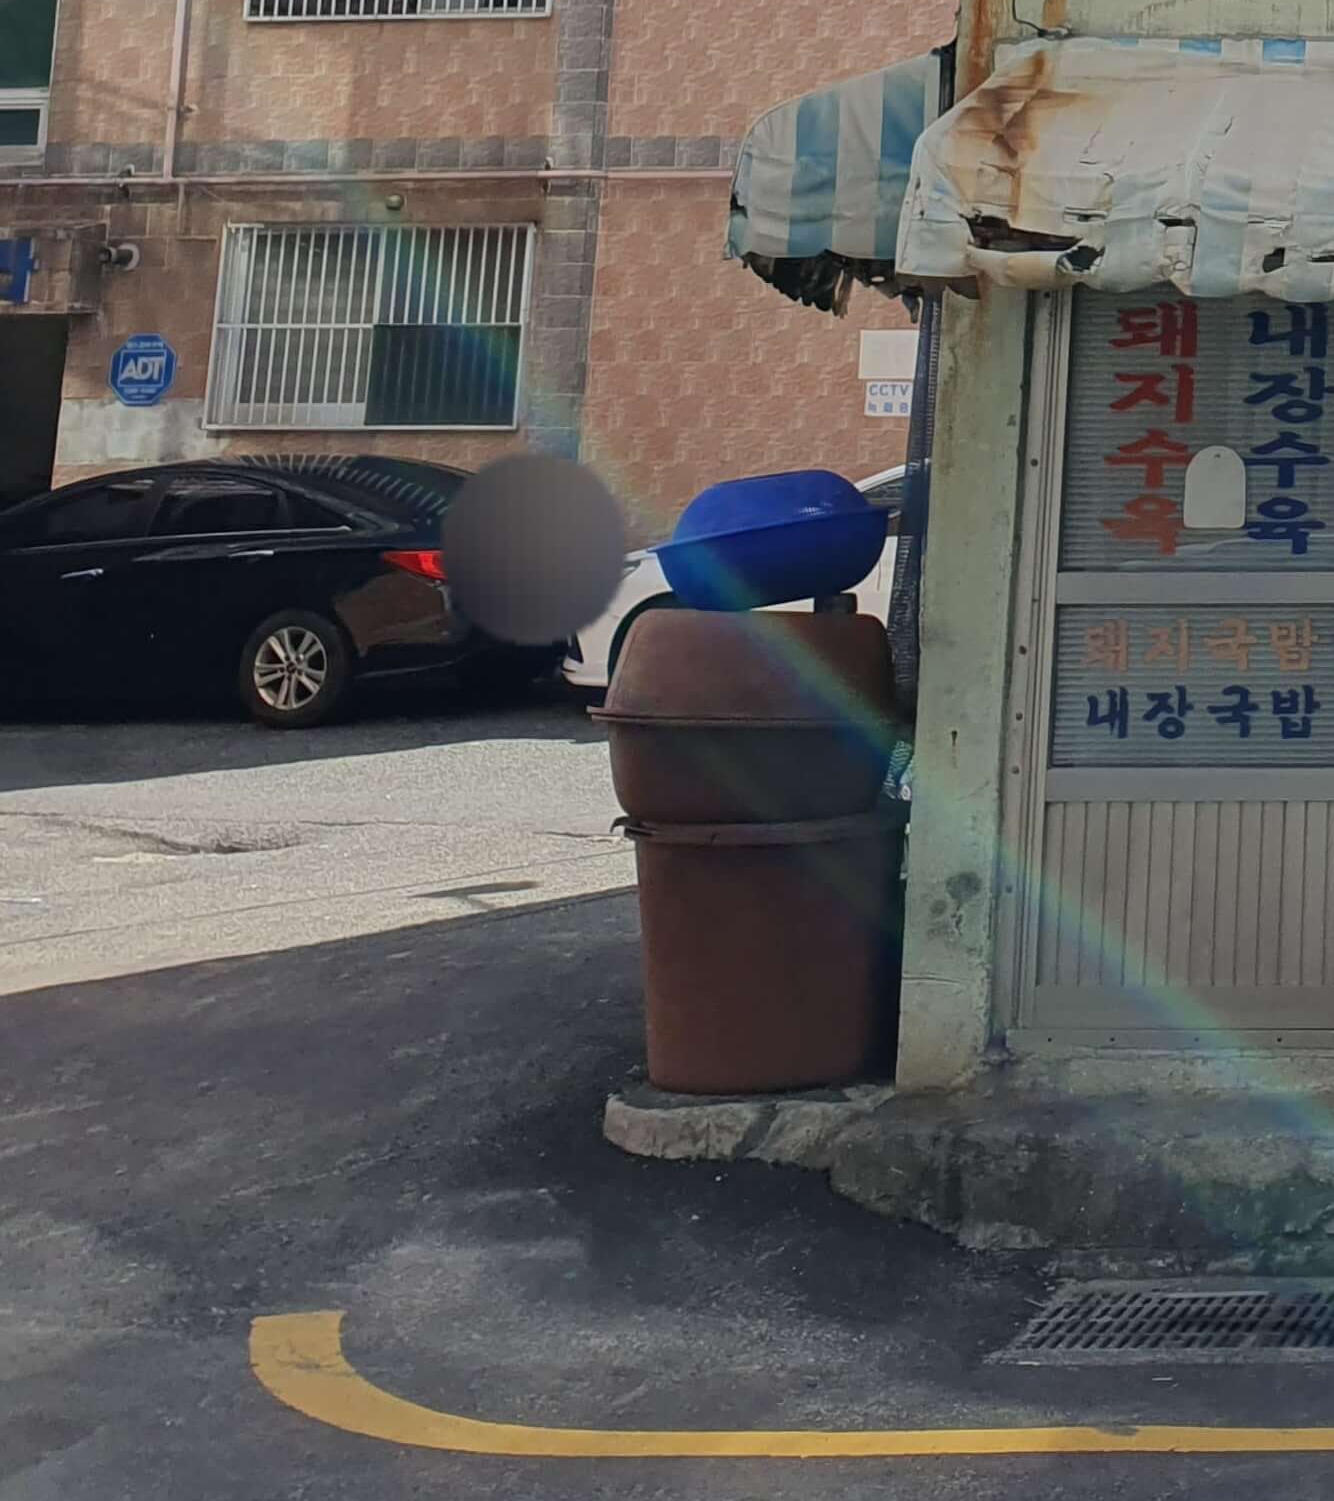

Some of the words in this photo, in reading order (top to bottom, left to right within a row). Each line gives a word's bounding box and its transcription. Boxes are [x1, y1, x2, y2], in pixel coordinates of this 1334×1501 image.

[120, 356, 164, 382] ADT
[869, 384, 909, 396] CCTV
[1099, 299, 1200, 557] 돼지수육
[1085, 684, 1323, 740] 내장국밥
